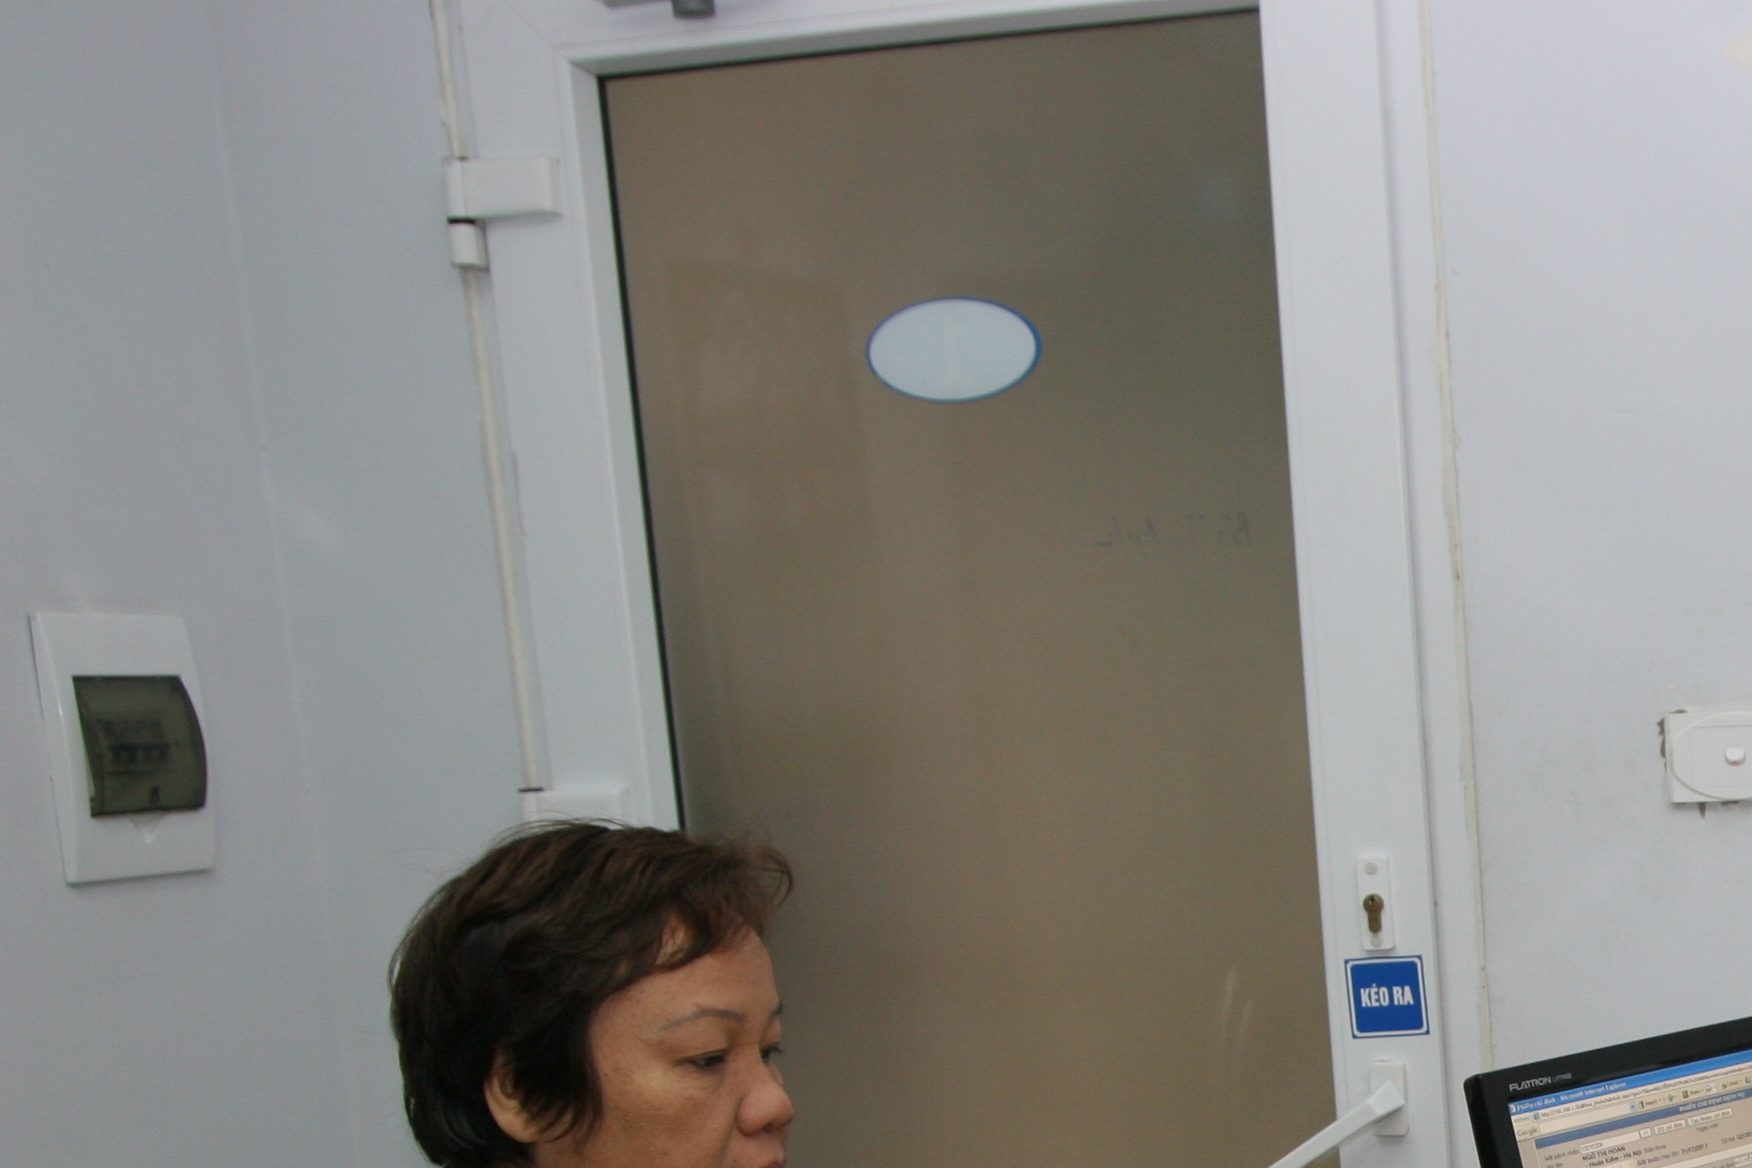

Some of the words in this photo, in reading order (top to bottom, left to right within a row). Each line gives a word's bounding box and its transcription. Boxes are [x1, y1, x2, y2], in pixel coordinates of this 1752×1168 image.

[1360, 983, 1390, 1008] KÉO
[1392, 985, 1415, 1006] RA
[1508, 1075, 1552, 1093] FLATRON
